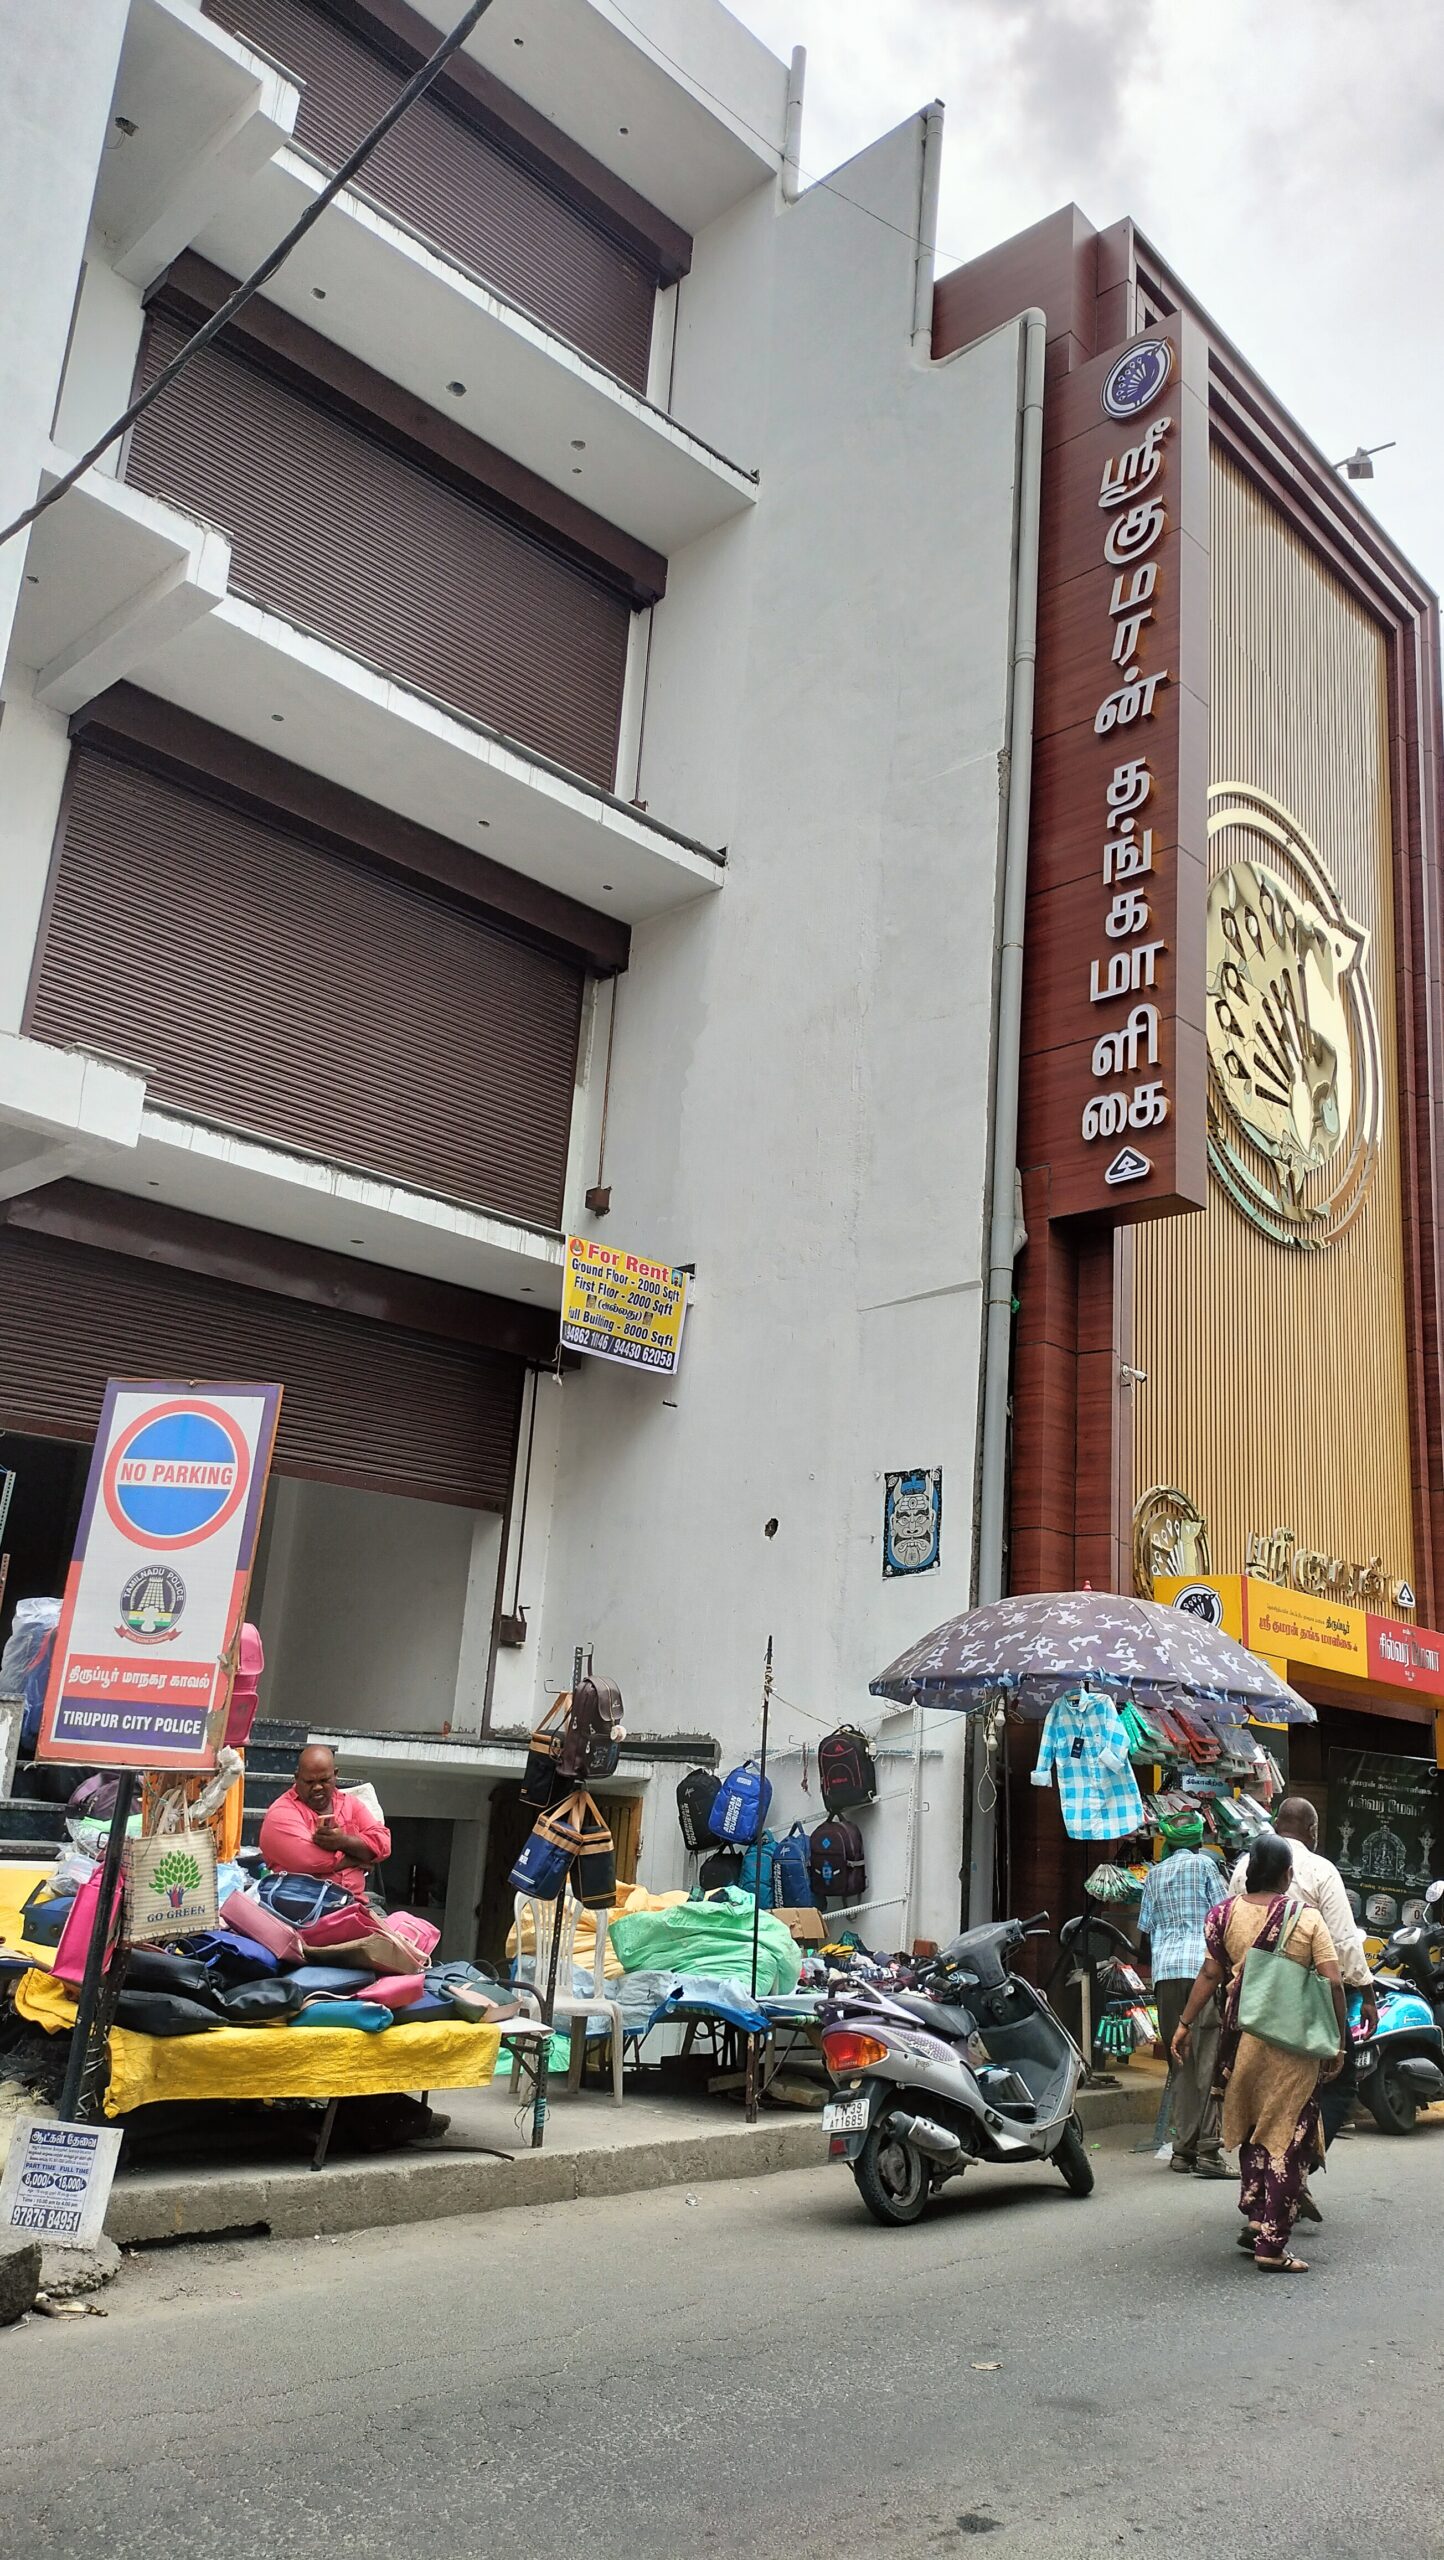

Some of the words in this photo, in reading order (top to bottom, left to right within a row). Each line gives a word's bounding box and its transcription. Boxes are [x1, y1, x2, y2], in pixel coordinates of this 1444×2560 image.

[588, 1243, 620, 1266] For
[626, 1253, 670, 1283] Rent
[572, 1258, 603, 1279] Ground
[638, 1278, 660, 1296] 2000
[662, 1286, 680, 1303] Sqft
[574, 1276, 595, 1293] First
[627, 1292, 650, 1309] 2000
[652, 1300, 673, 1316] Sqft
[624, 1324, 649, 1341] 8000
[650, 1330, 674, 1347] Sqft
[613, 1339, 641, 1359] 94430
[642, 1347, 673, 1367] 62058
[120, 1461, 146, 1482] NO
[152, 1464, 233, 1486] PARKING
[124, 1567, 165, 1598] TAMILNADU
[167, 1571, 184, 1601] POLICE
[1272, 1619, 1299, 1637] குமரன்
[68, 1664, 120, 1685] திருப்பூர்
[122, 1670, 167, 1689] மாநகர
[170, 1670, 211, 1690] காவல்
[63, 1710, 120, 1729] TIRUPUR
[123, 1714, 153, 1731] CITY
[155, 1716, 202, 1735] POLICE
[722, 1795, 737, 1833] AMERICAN
[728, 1797, 743, 1835] TOURISTER
[147, 1912, 163, 1923] GO
[166, 1904, 206, 1919] GREEN
[31, 2130, 67, 2145] ஆட்கள்
[67, 2133, 97, 2147] தேவை
[12, 2206, 47, 2228] 97876
[46, 2210, 80, 2231] 84951
